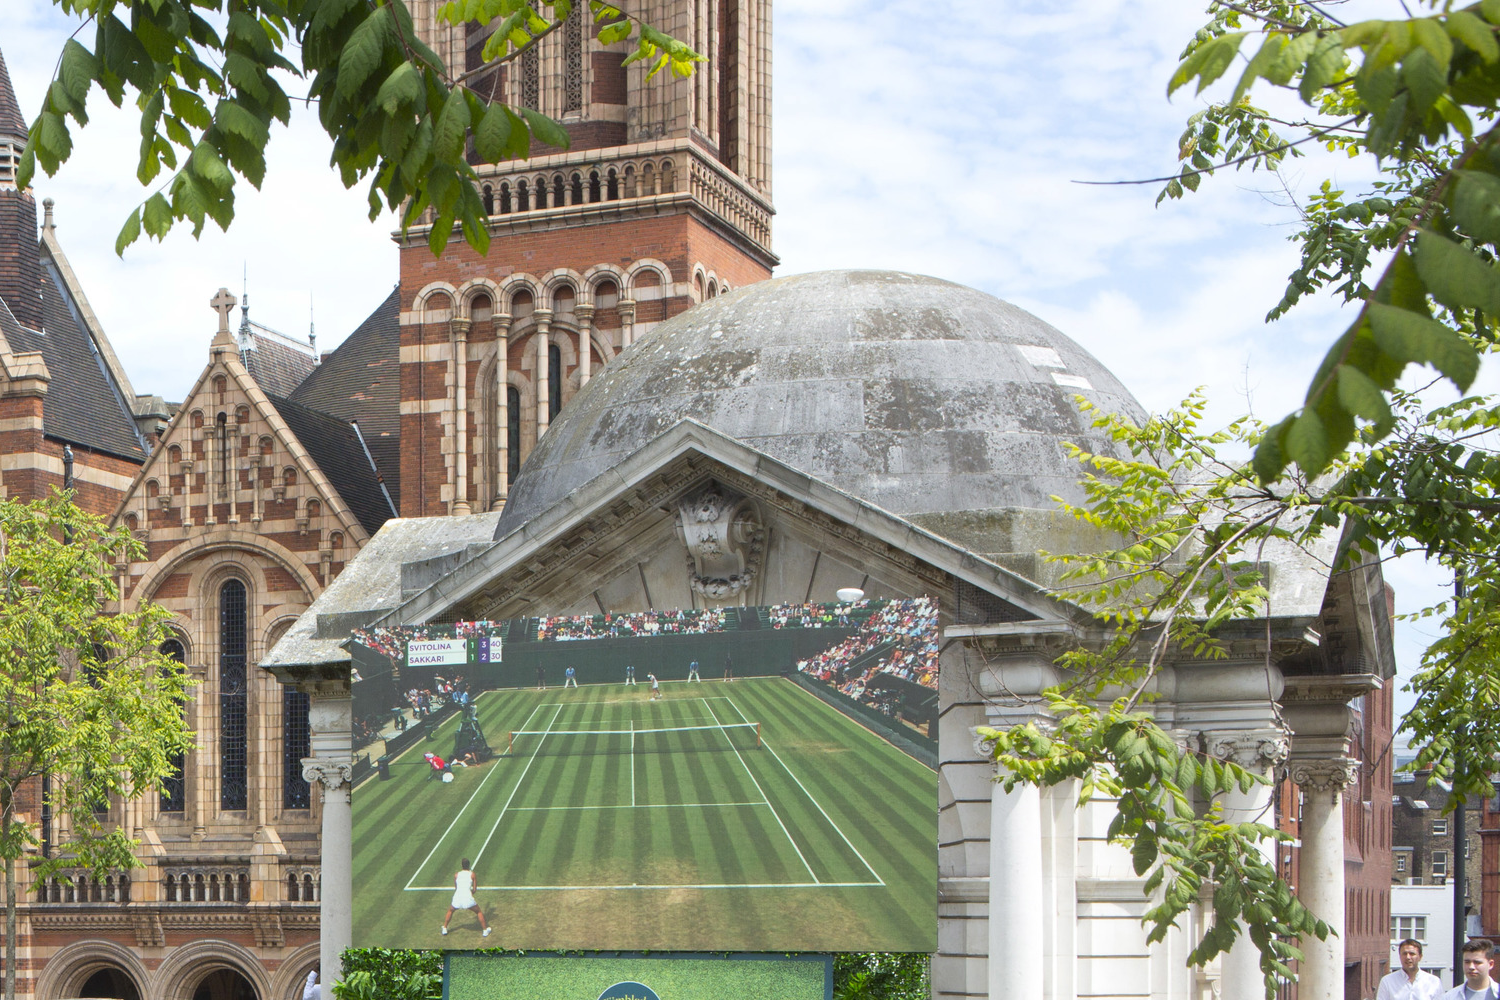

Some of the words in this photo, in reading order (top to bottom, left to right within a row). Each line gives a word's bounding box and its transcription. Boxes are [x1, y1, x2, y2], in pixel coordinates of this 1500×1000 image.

[409, 643, 452, 652] SVITOLINA
[470, 641, 475, 649] 1
[481, 641, 487, 649] 3
[409, 655, 445, 664] SAKKARI
[470, 653, 475, 661] 1
[481, 653, 487, 661] 2
